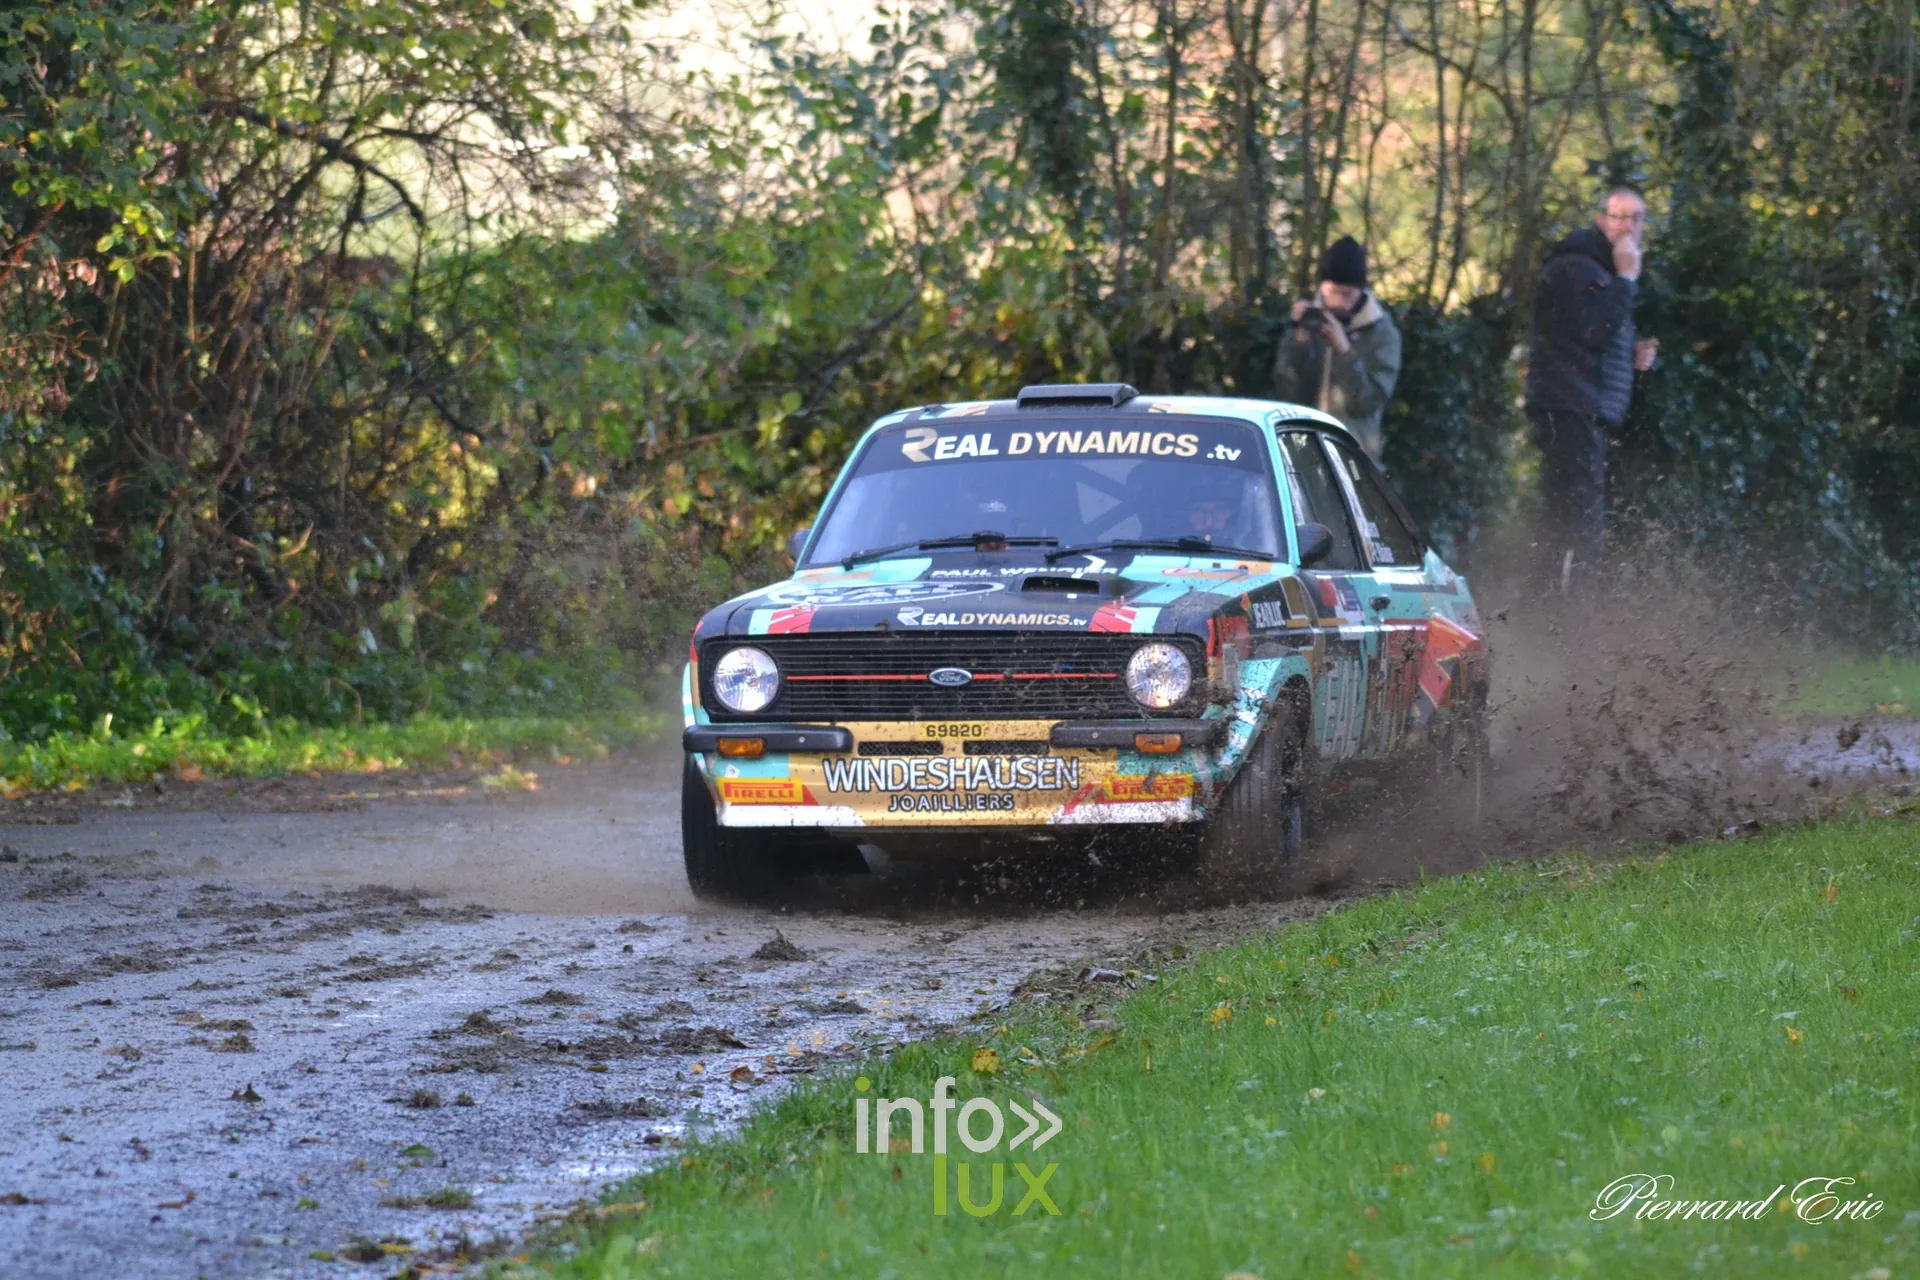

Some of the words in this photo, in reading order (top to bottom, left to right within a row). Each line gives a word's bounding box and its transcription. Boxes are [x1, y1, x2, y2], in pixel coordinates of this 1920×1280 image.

[902, 427, 999, 463] REAL
[1007, 431, 1200, 457] DYNAMICS
[1206, 443, 1242, 461] .tv
[931, 568, 992, 577] PAUL
[925, 724, 983, 738] 69820
[823, 756, 1080, 793] WINDESHAUSEN
[723, 782, 796, 798] PIRELLI
[887, 793, 1015, 812] JOAILLIERS
